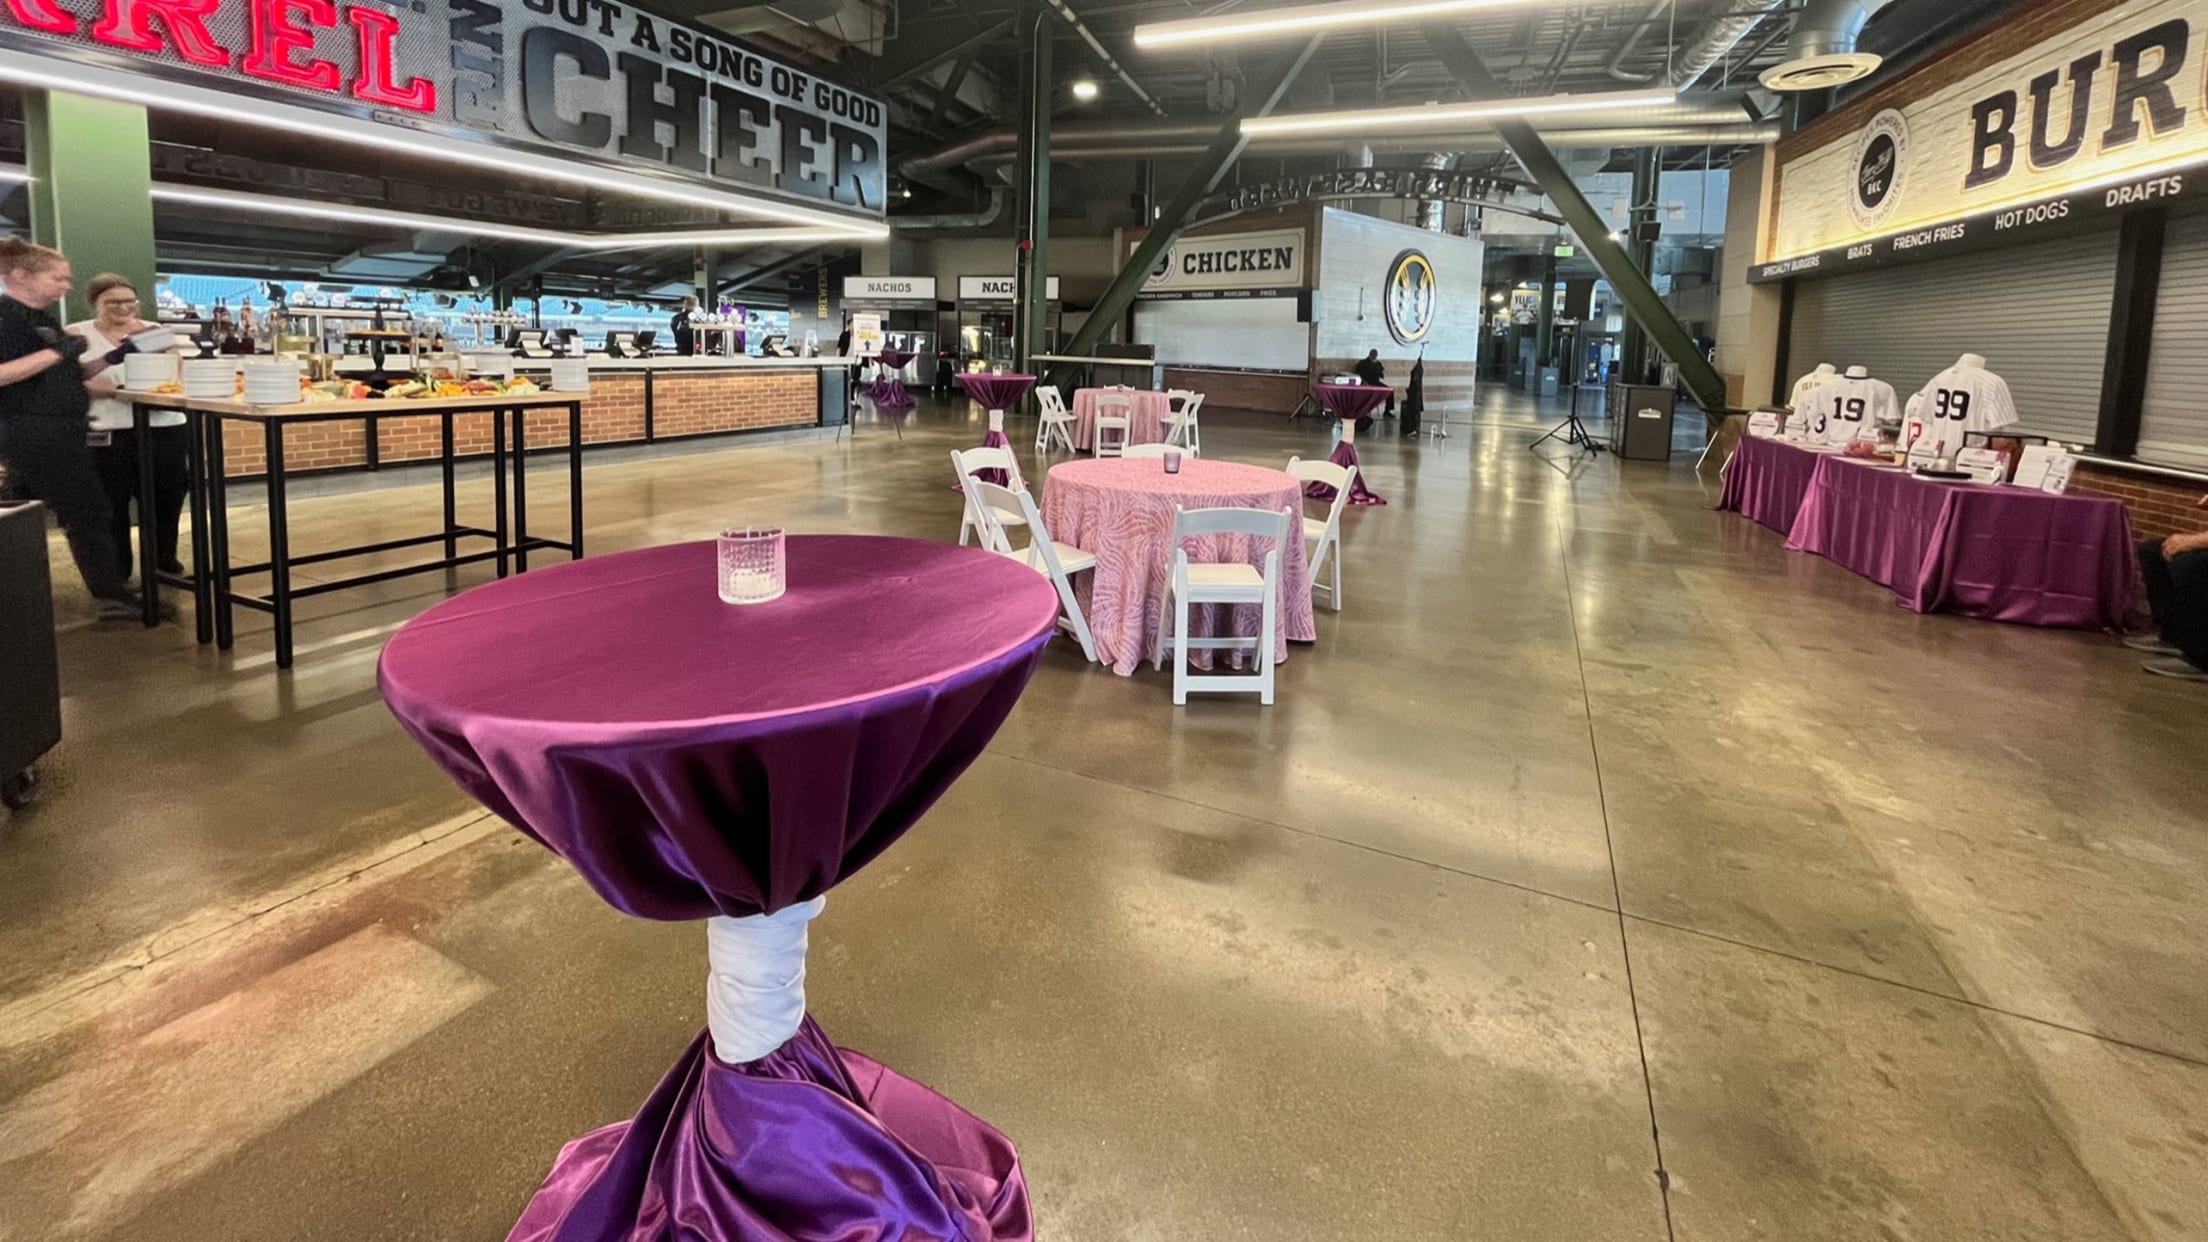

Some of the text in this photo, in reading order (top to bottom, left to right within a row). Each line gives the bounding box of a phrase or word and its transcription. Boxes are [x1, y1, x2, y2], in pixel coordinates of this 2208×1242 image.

[0, 0, 436, 112] REL
[450, 0, 505, 130] RIN
[631, 15, 661, 53] A
[669, 27, 763, 89] SONG
[771, 66, 808, 103] OF
[814, 84, 881, 128] GOOD
[1963, 18, 2208, 190] BUR
[523, 26, 882, 209] CHEER
[1183, 247, 1293, 274] CHICKEN
[1763, 175, 2182, 277] SPECIALTY BURGERS BRATS FRENCH FRIES HOT DOGS DRAFTS
[867, 282, 912, 293] NACHOS
[982, 282, 1016, 293] NACH
[1833, 396, 1866, 422] 19
